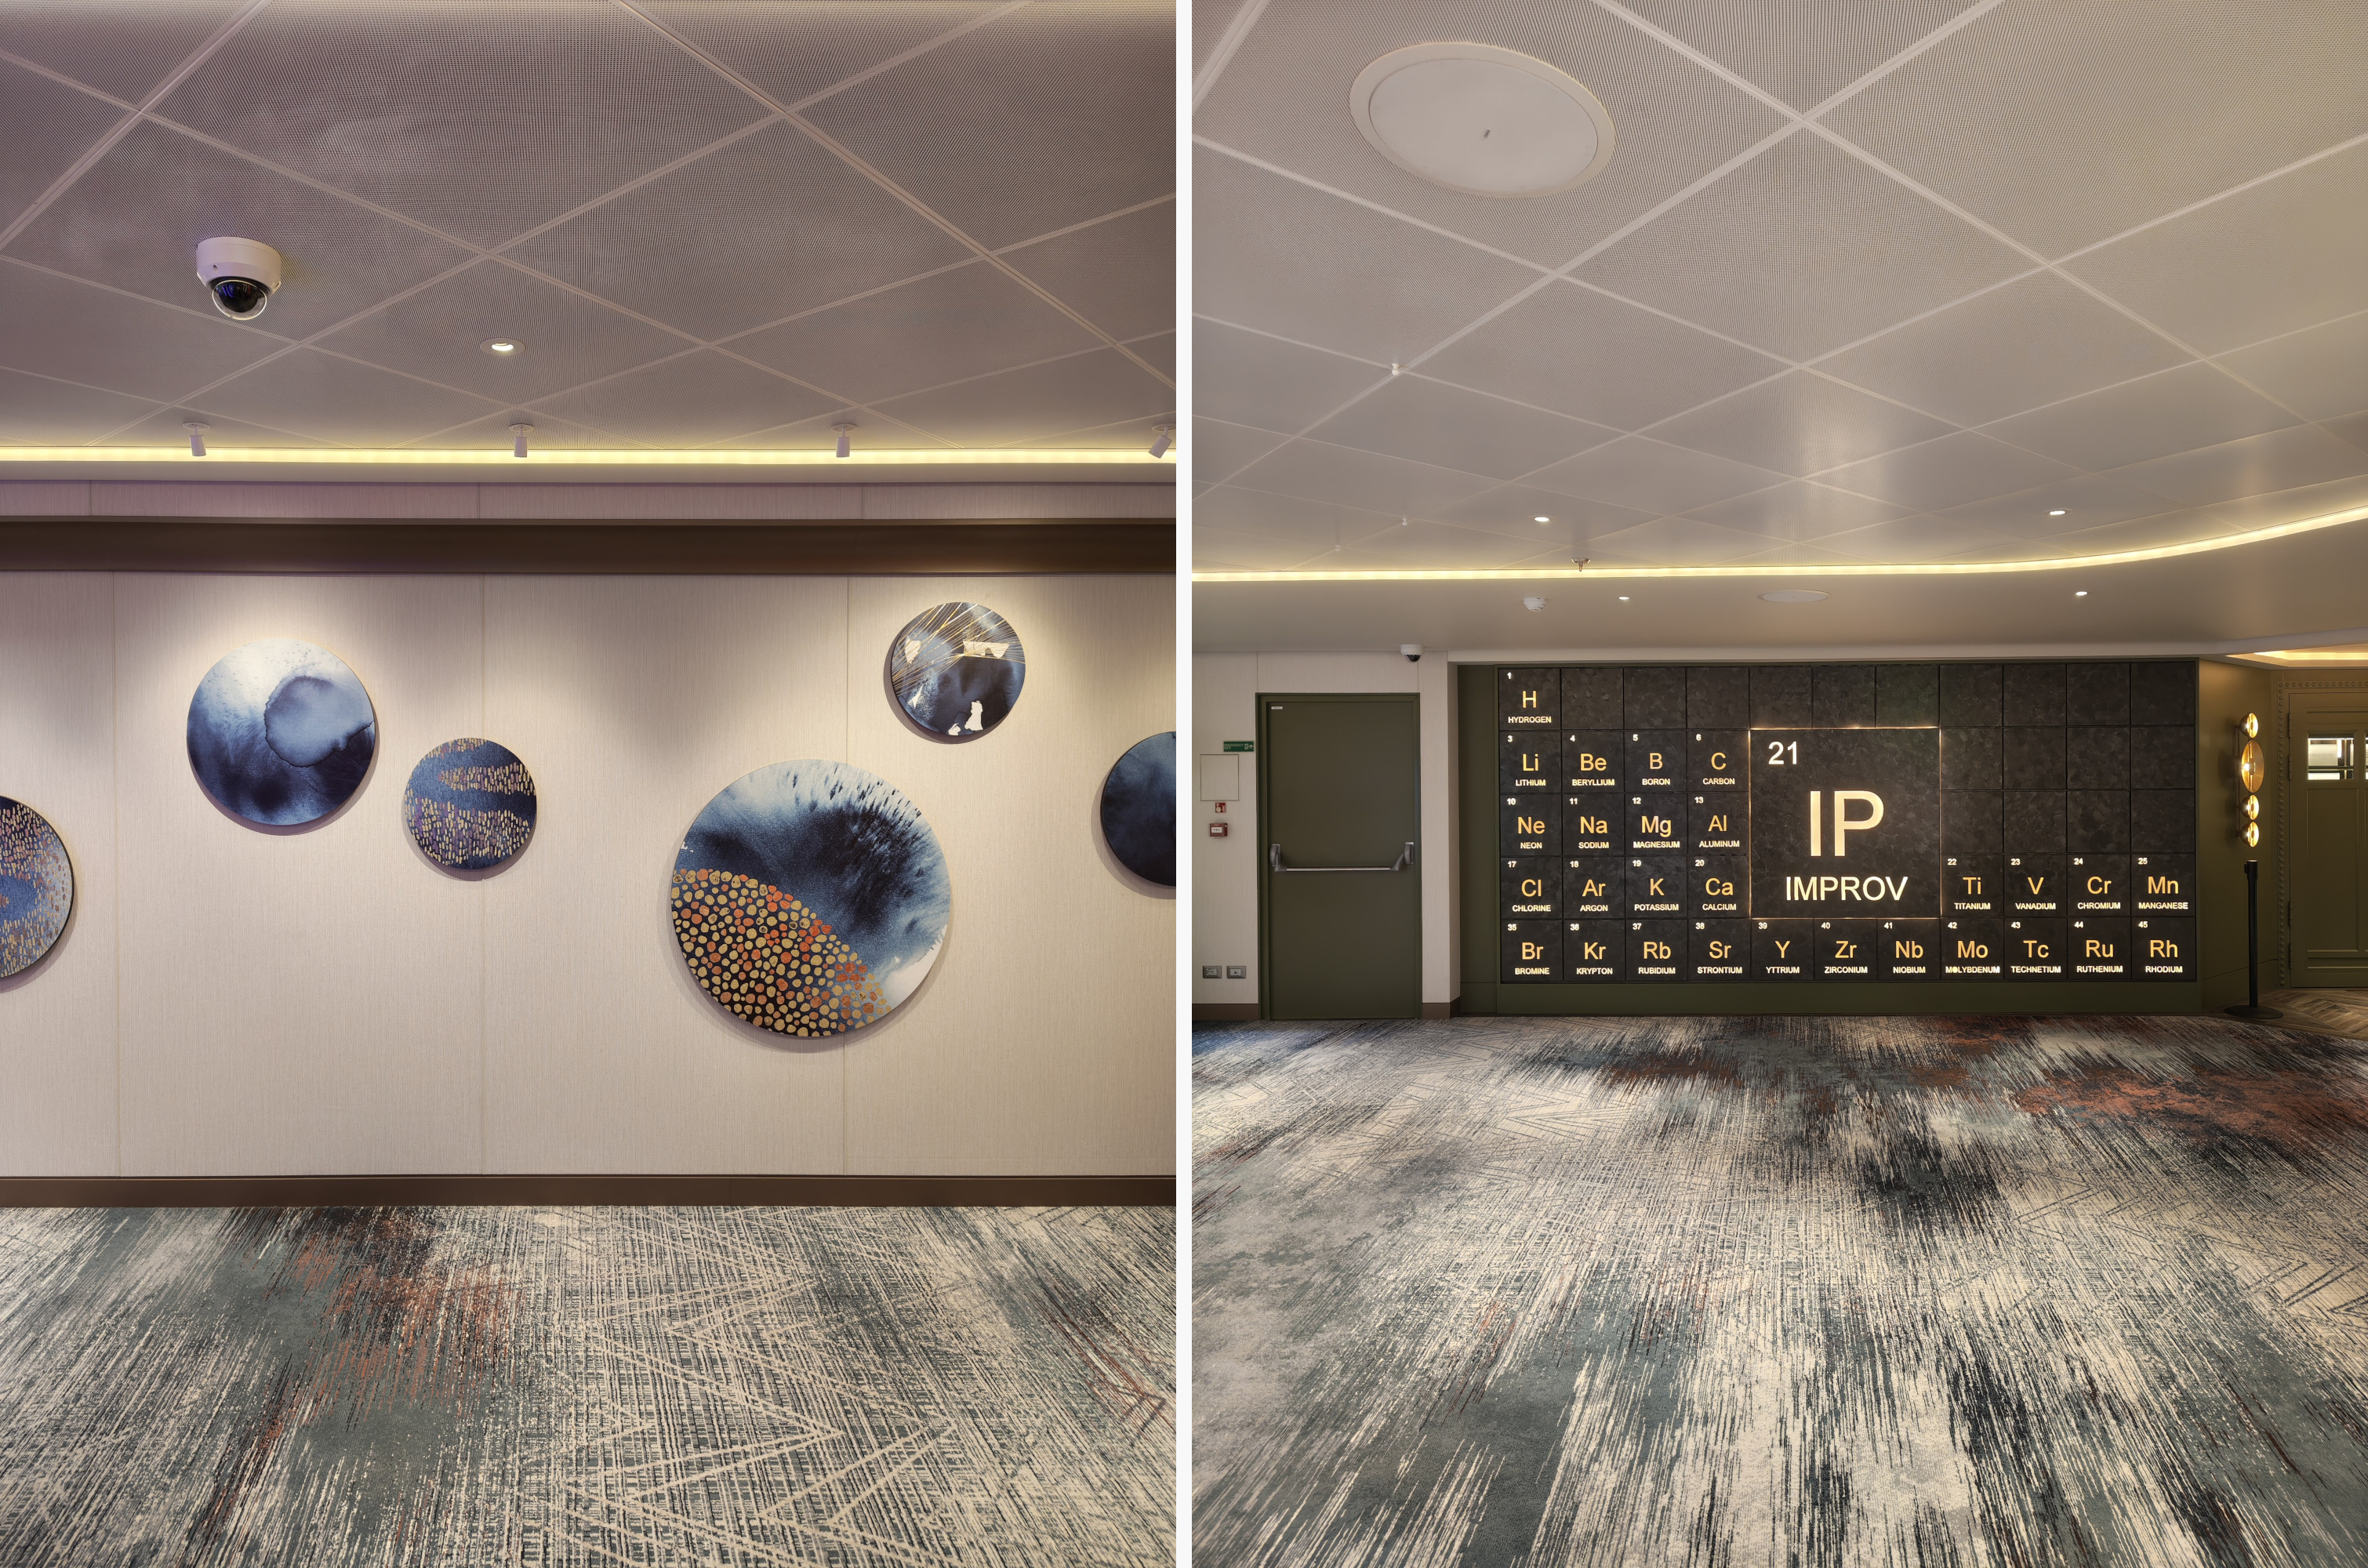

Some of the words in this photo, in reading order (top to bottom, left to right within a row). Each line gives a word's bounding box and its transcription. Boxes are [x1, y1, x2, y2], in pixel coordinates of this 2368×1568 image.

[1506, 671, 1513, 680] 1
[1522, 690, 1537, 709] H
[1508, 715, 1553, 724] HYDROGEN
[1507, 735, 1513, 743] 3
[1569, 734, 1576, 742] 4
[1633, 733, 1639, 742] 5
[1695, 733, 1702, 742] 6
[1767, 740, 1797, 765] 21
[1522, 753, 1539, 771] Li
[1580, 753, 1607, 771] Be
[1649, 752, 1663, 770] B
[1710, 752, 1727, 771] C
[1515, 779, 1546, 787] LITHIUM
[1702, 777, 1735, 786] CARBON
[1506, 797, 1516, 806] 10
[1694, 796, 1704, 804] 13
[1517, 816, 1545, 835] Ne
[1580, 815, 1608, 834] Na
[1641, 815, 1672, 838] Mg
[1708, 815, 1727, 832] Al
[1810, 789, 1885, 857] IP
[1520, 841, 1543, 850] NEON
[1633, 840, 1680, 849] MAGNESIUM
[1698, 840, 1740, 848] ALUMINUM
[1694, 858, 1705, 867] 20
[2073, 857, 2084, 866] 24
[1521, 878, 1542, 898] Cl
[1582, 879, 1607, 897] Ar
[1650, 877, 1665, 896] K
[1705, 877, 1734, 896] Ca
[1785, 876, 1909, 902] IMPROV
[1962, 877, 1981, 895] Ti
[2027, 877, 2044, 895] V
[2087, 876, 2112, 895] Cr
[2148, 876, 2179, 895] Mn
[1512, 904, 1552, 913] CHLORINE
[1579, 904, 1609, 913] ARGON
[1633, 903, 1680, 912] POTASSIUM
[1953, 902, 1991, 910] TITANIUM
[2077, 902, 2121, 910] CHROMIUM
[2138, 902, 2189, 910] MANGANESE
[1507, 923, 1517, 931] 35
[1570, 923, 1580, 931] 36
[1632, 922, 1643, 931] 37
[1758, 921, 1768, 930] 39
[1821, 921, 1831, 930] 40
[1883, 921, 1893, 930] 41
[2073, 920, 2084, 929] 44
[1521, 942, 1544, 960] Br
[1584, 942, 1607, 960] Kr
[1643, 941, 1672, 960] Rb
[1709, 940, 1732, 959] Sr
[1774, 940, 1791, 959] Y
[1835, 940, 1858, 959] Zr
[1895, 940, 1924, 959] Nb
[1957, 940, 1988, 959] Mo
[2023, 940, 2050, 959] Tc
[2086, 939, 2114, 958] Ru
[2149, 939, 2178, 958] Rh
[1514, 967, 1550, 975] BROMINE
[1576, 967, 1614, 975] KRYPTON
[1697, 966, 1743, 975] STRONTIUM
[1945, 965, 2001, 974] MOLYBDENUM
[2010, 965, 2061, 974] TECHNETIUM
[2145, 965, 2183, 974] RHODIUM
